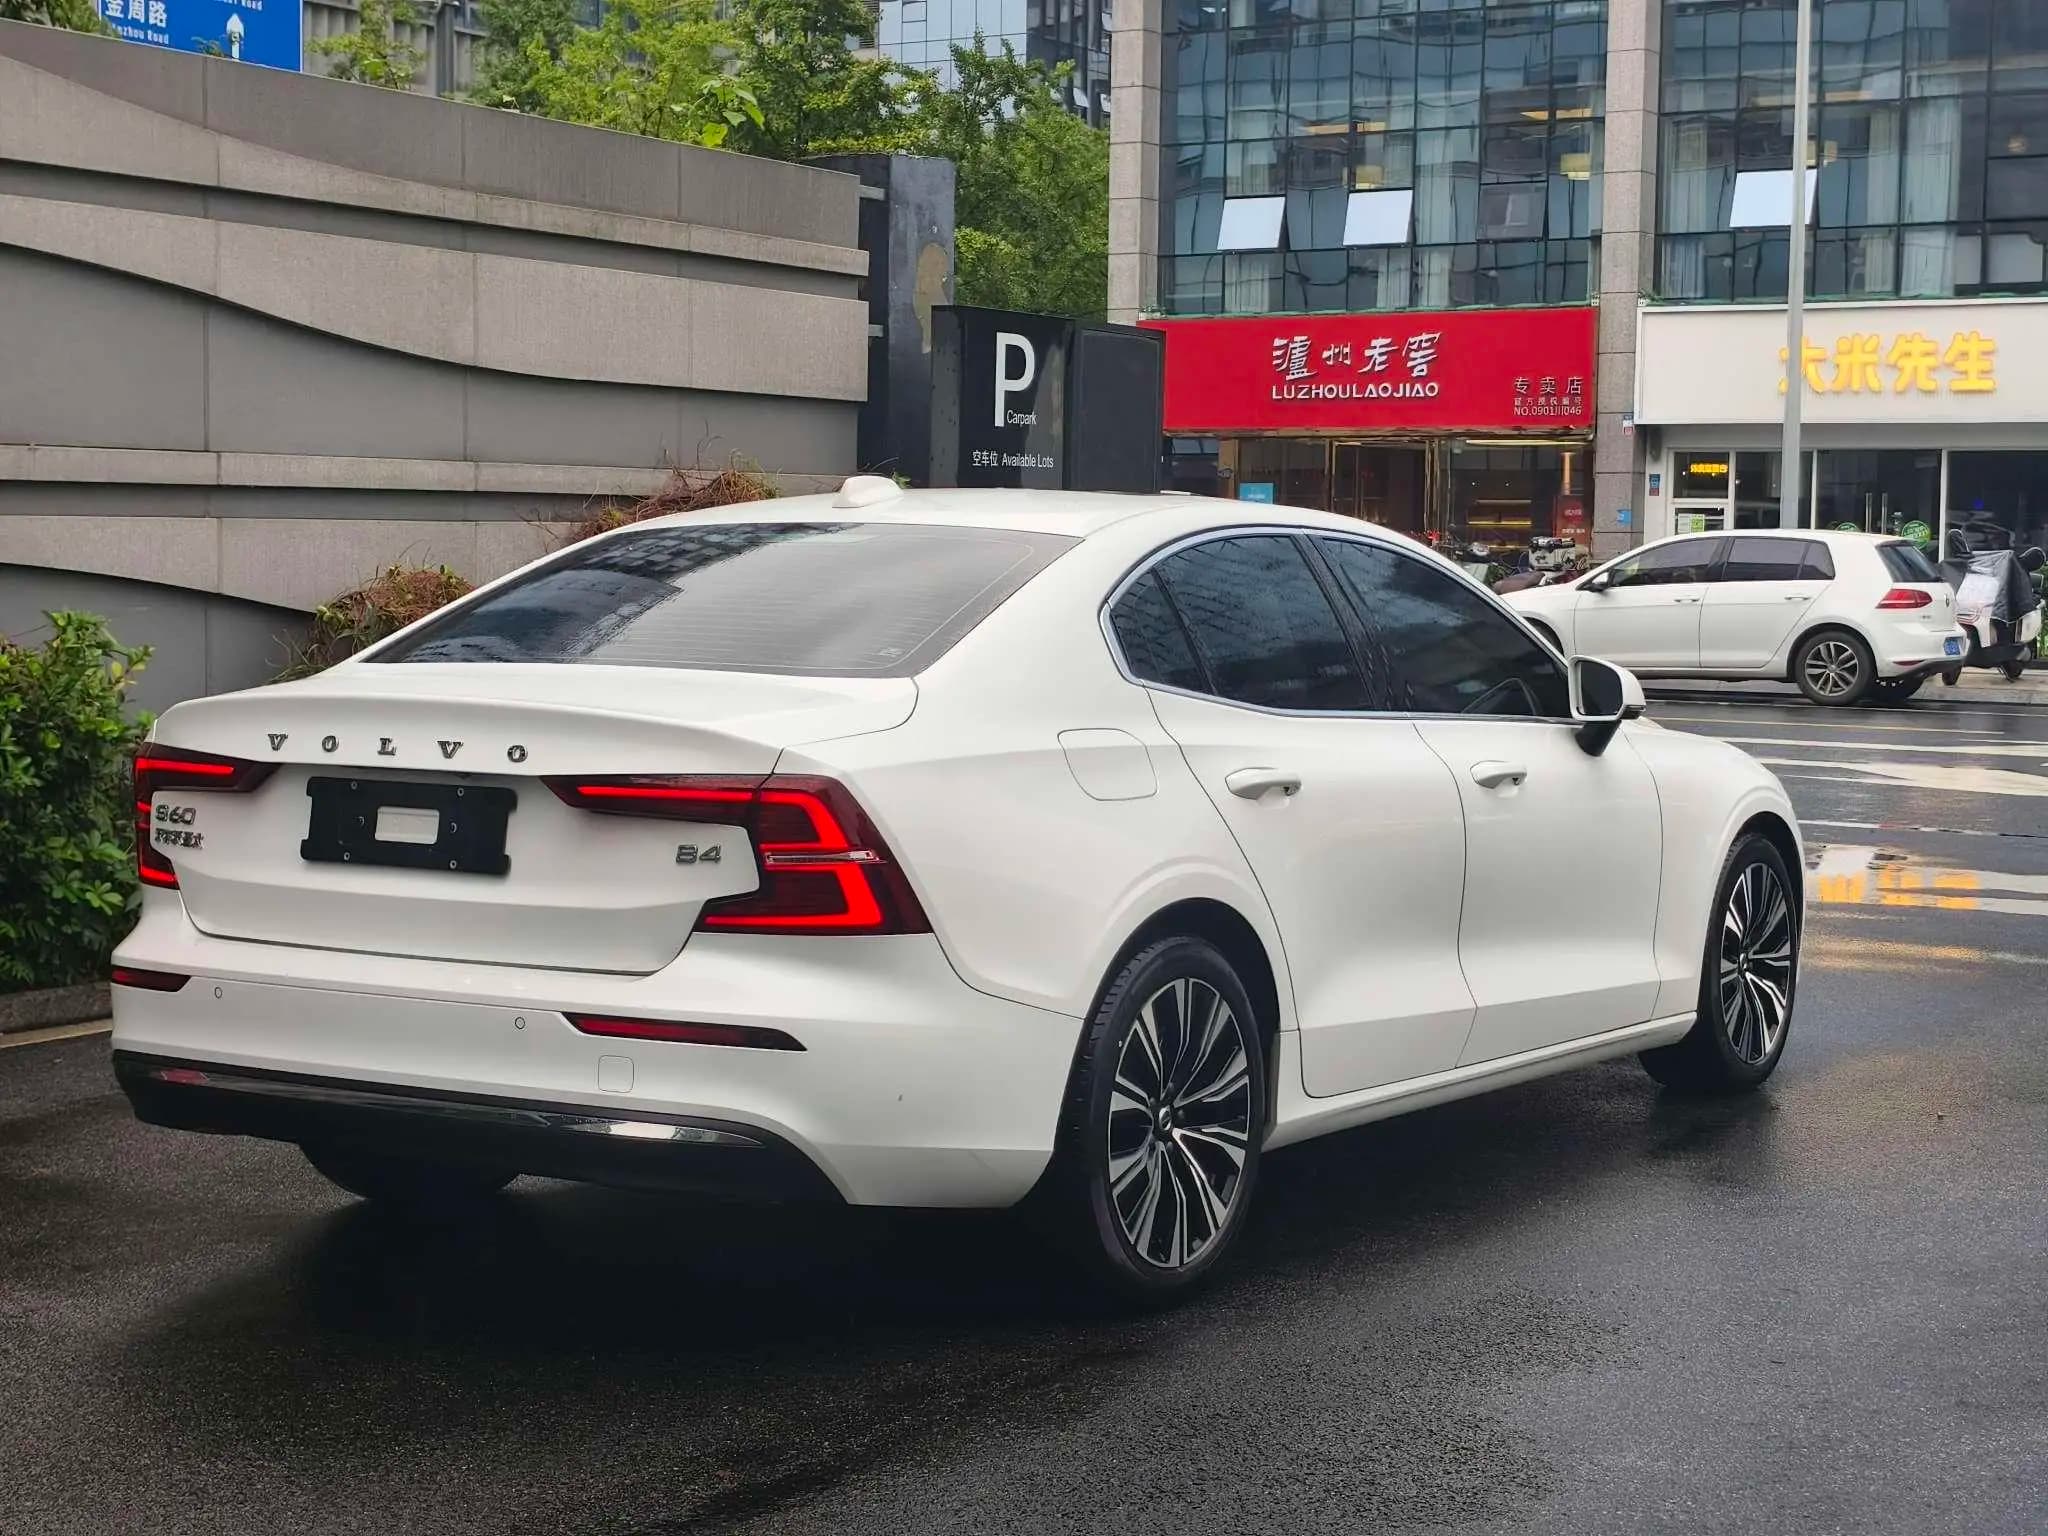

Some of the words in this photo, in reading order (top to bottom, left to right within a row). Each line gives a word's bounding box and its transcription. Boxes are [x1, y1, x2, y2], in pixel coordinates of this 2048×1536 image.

[147, 29, 169, 45] Road
[1778, 330, 1996, 394] 大米先生
[994, 331, 1036, 427] P
[1513, 376, 1584, 394] 专卖店
[1271, 381, 1440, 400] LUZHOULAOJIAO
[1006, 409, 1037, 427] Carpark
[972, 449, 999, 468] 空车位
[1001, 452, 1037, 468] Available
[1037, 453, 1055, 469] Lots
[267, 732, 529, 764] VOLVO
[155, 803, 197, 826] S60
[675, 843, 722, 865] B4
